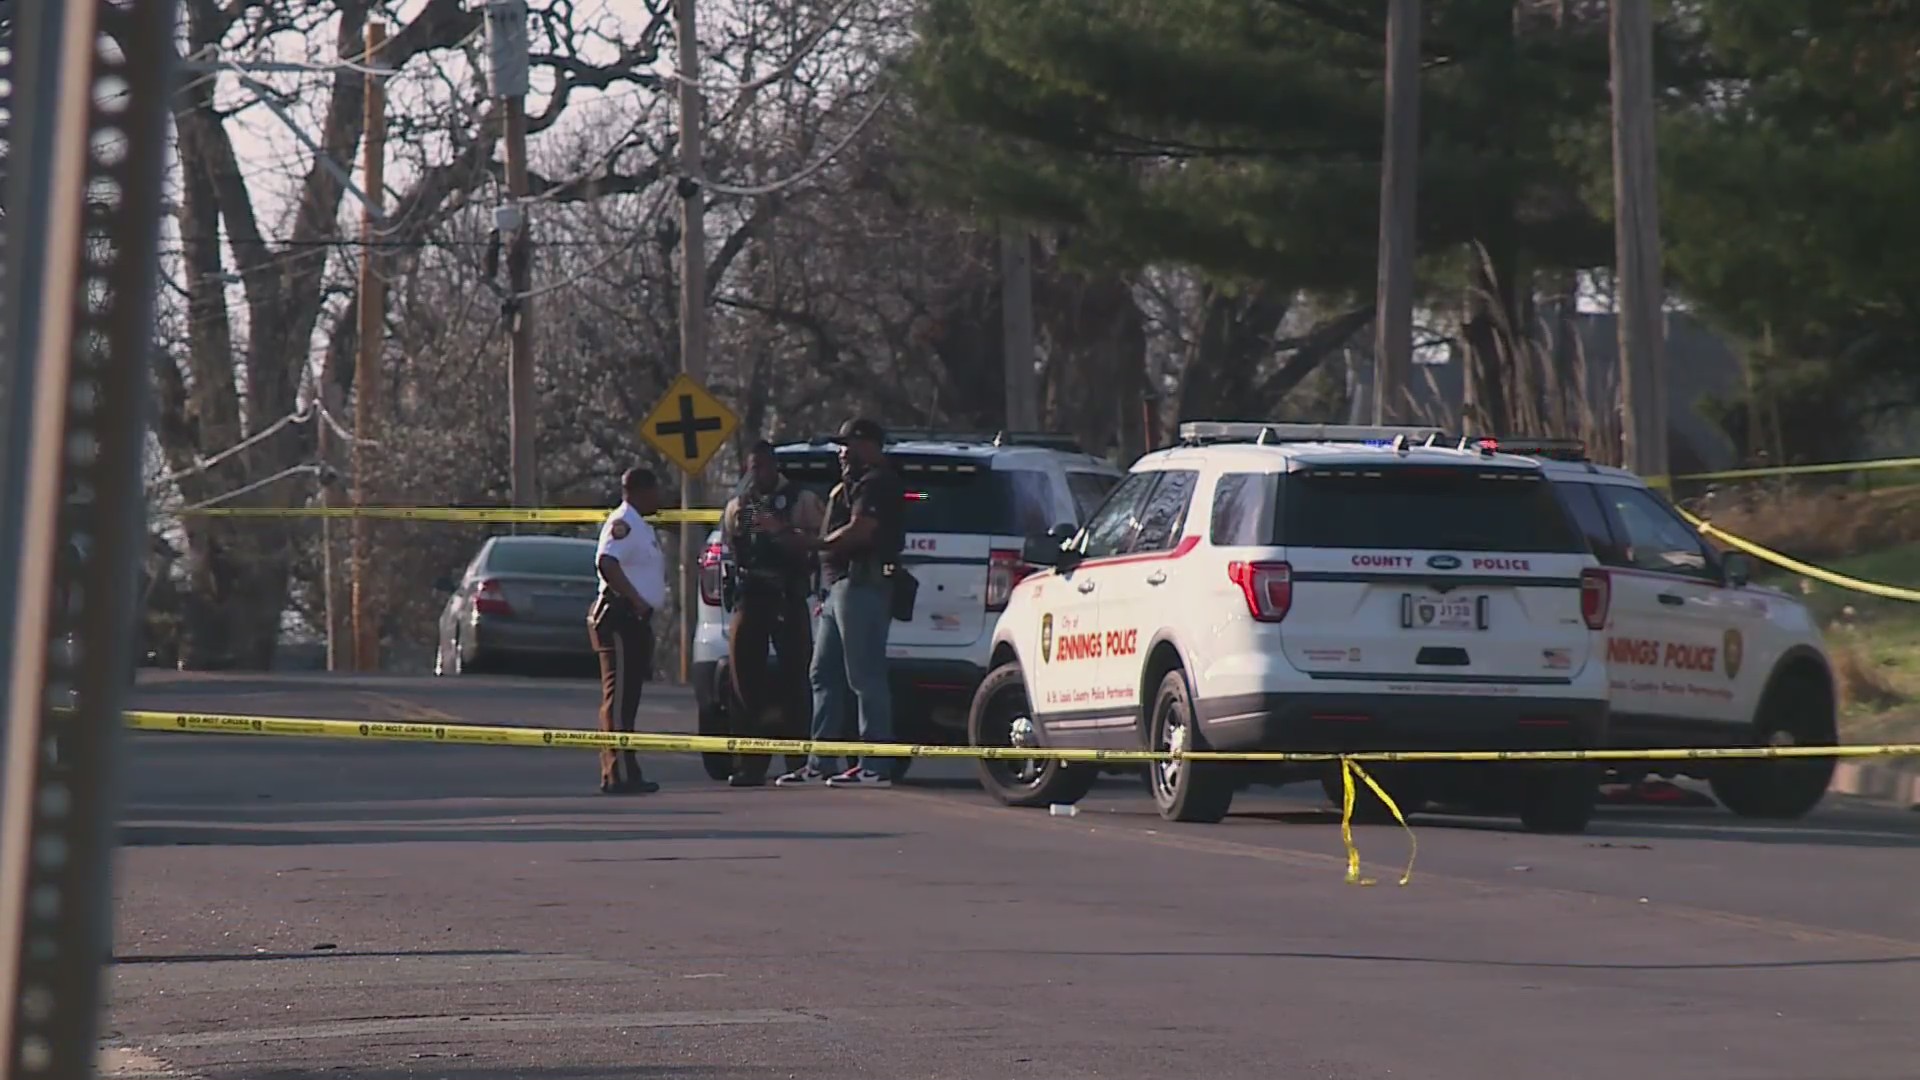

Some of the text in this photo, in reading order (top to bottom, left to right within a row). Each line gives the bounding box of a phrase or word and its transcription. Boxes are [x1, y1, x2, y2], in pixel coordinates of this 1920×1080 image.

[1351, 554, 1413, 568] COUNTY
[1472, 558, 1531, 571] POLICE
[1056, 628, 1137, 661] JENNINGS POLICE
[1663, 643, 1717, 672] POLICE
